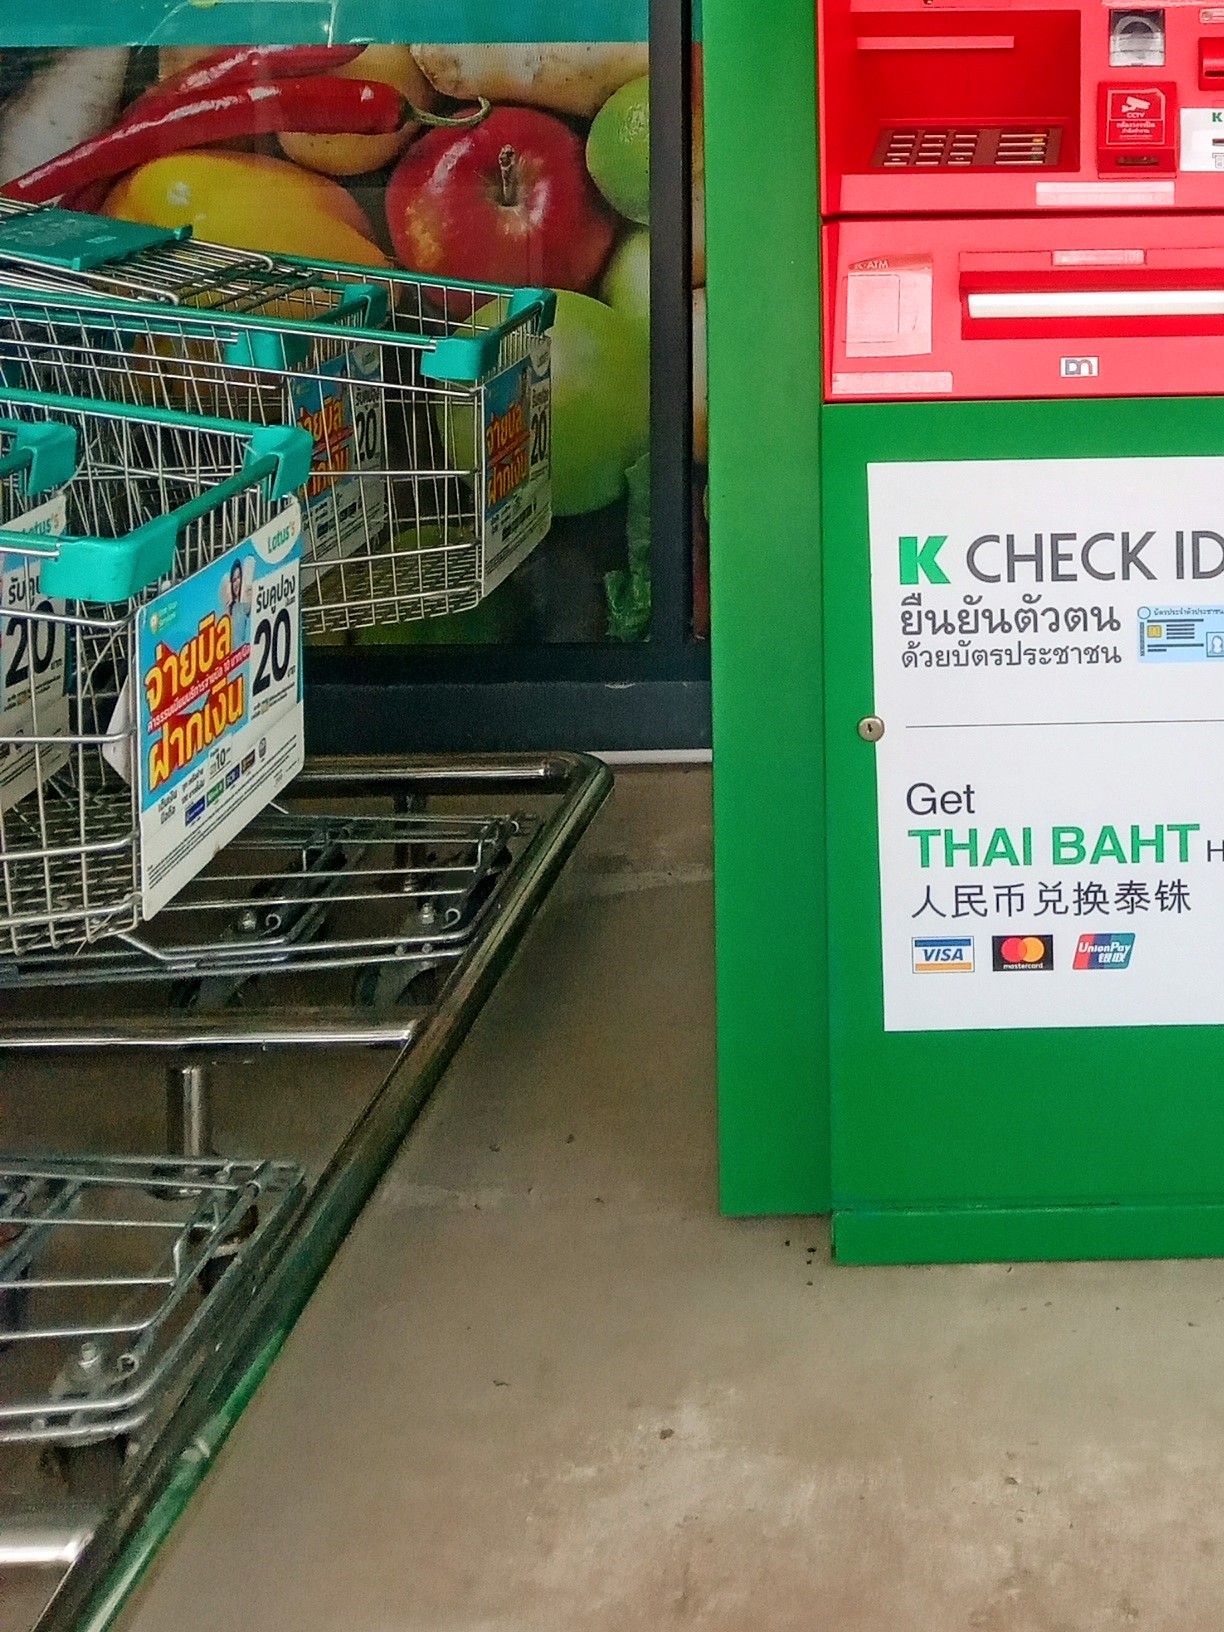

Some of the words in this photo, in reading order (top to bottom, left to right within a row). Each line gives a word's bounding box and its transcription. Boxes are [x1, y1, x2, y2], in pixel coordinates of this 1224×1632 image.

[1126, 111, 1145, 119] CCTV
[1212, 112, 1223, 123] K
[530, 411, 548, 467] 20
[898, 535, 952, 586] K
[965, 530, 1158, 584] CHECK
[256, 574, 296, 614] รับคูปอง
[901, 591, 1122, 638] ยืนยันตัวตน
[5, 600, 56, 688] 20
[144, 612, 232, 712] จ่ายบิล
[252, 608, 292, 697] 20
[901, 638, 1123, 669] ด้วยบัตรประชาชน
[148, 675, 244, 792] ฝากเงิน
[905, 782, 976, 816] Get
[907, 826, 1033, 869] THAI
[1051, 823, 1200, 866] BAHT
[911, 878, 1192, 919] 人民币兑换泰铢
[922, 947, 964, 962] VISA
[1003, 962, 1044, 970] mastercard
[1078, 941, 1131, 954] UnionPay
[1098, 952, 1126, 963] 银联
